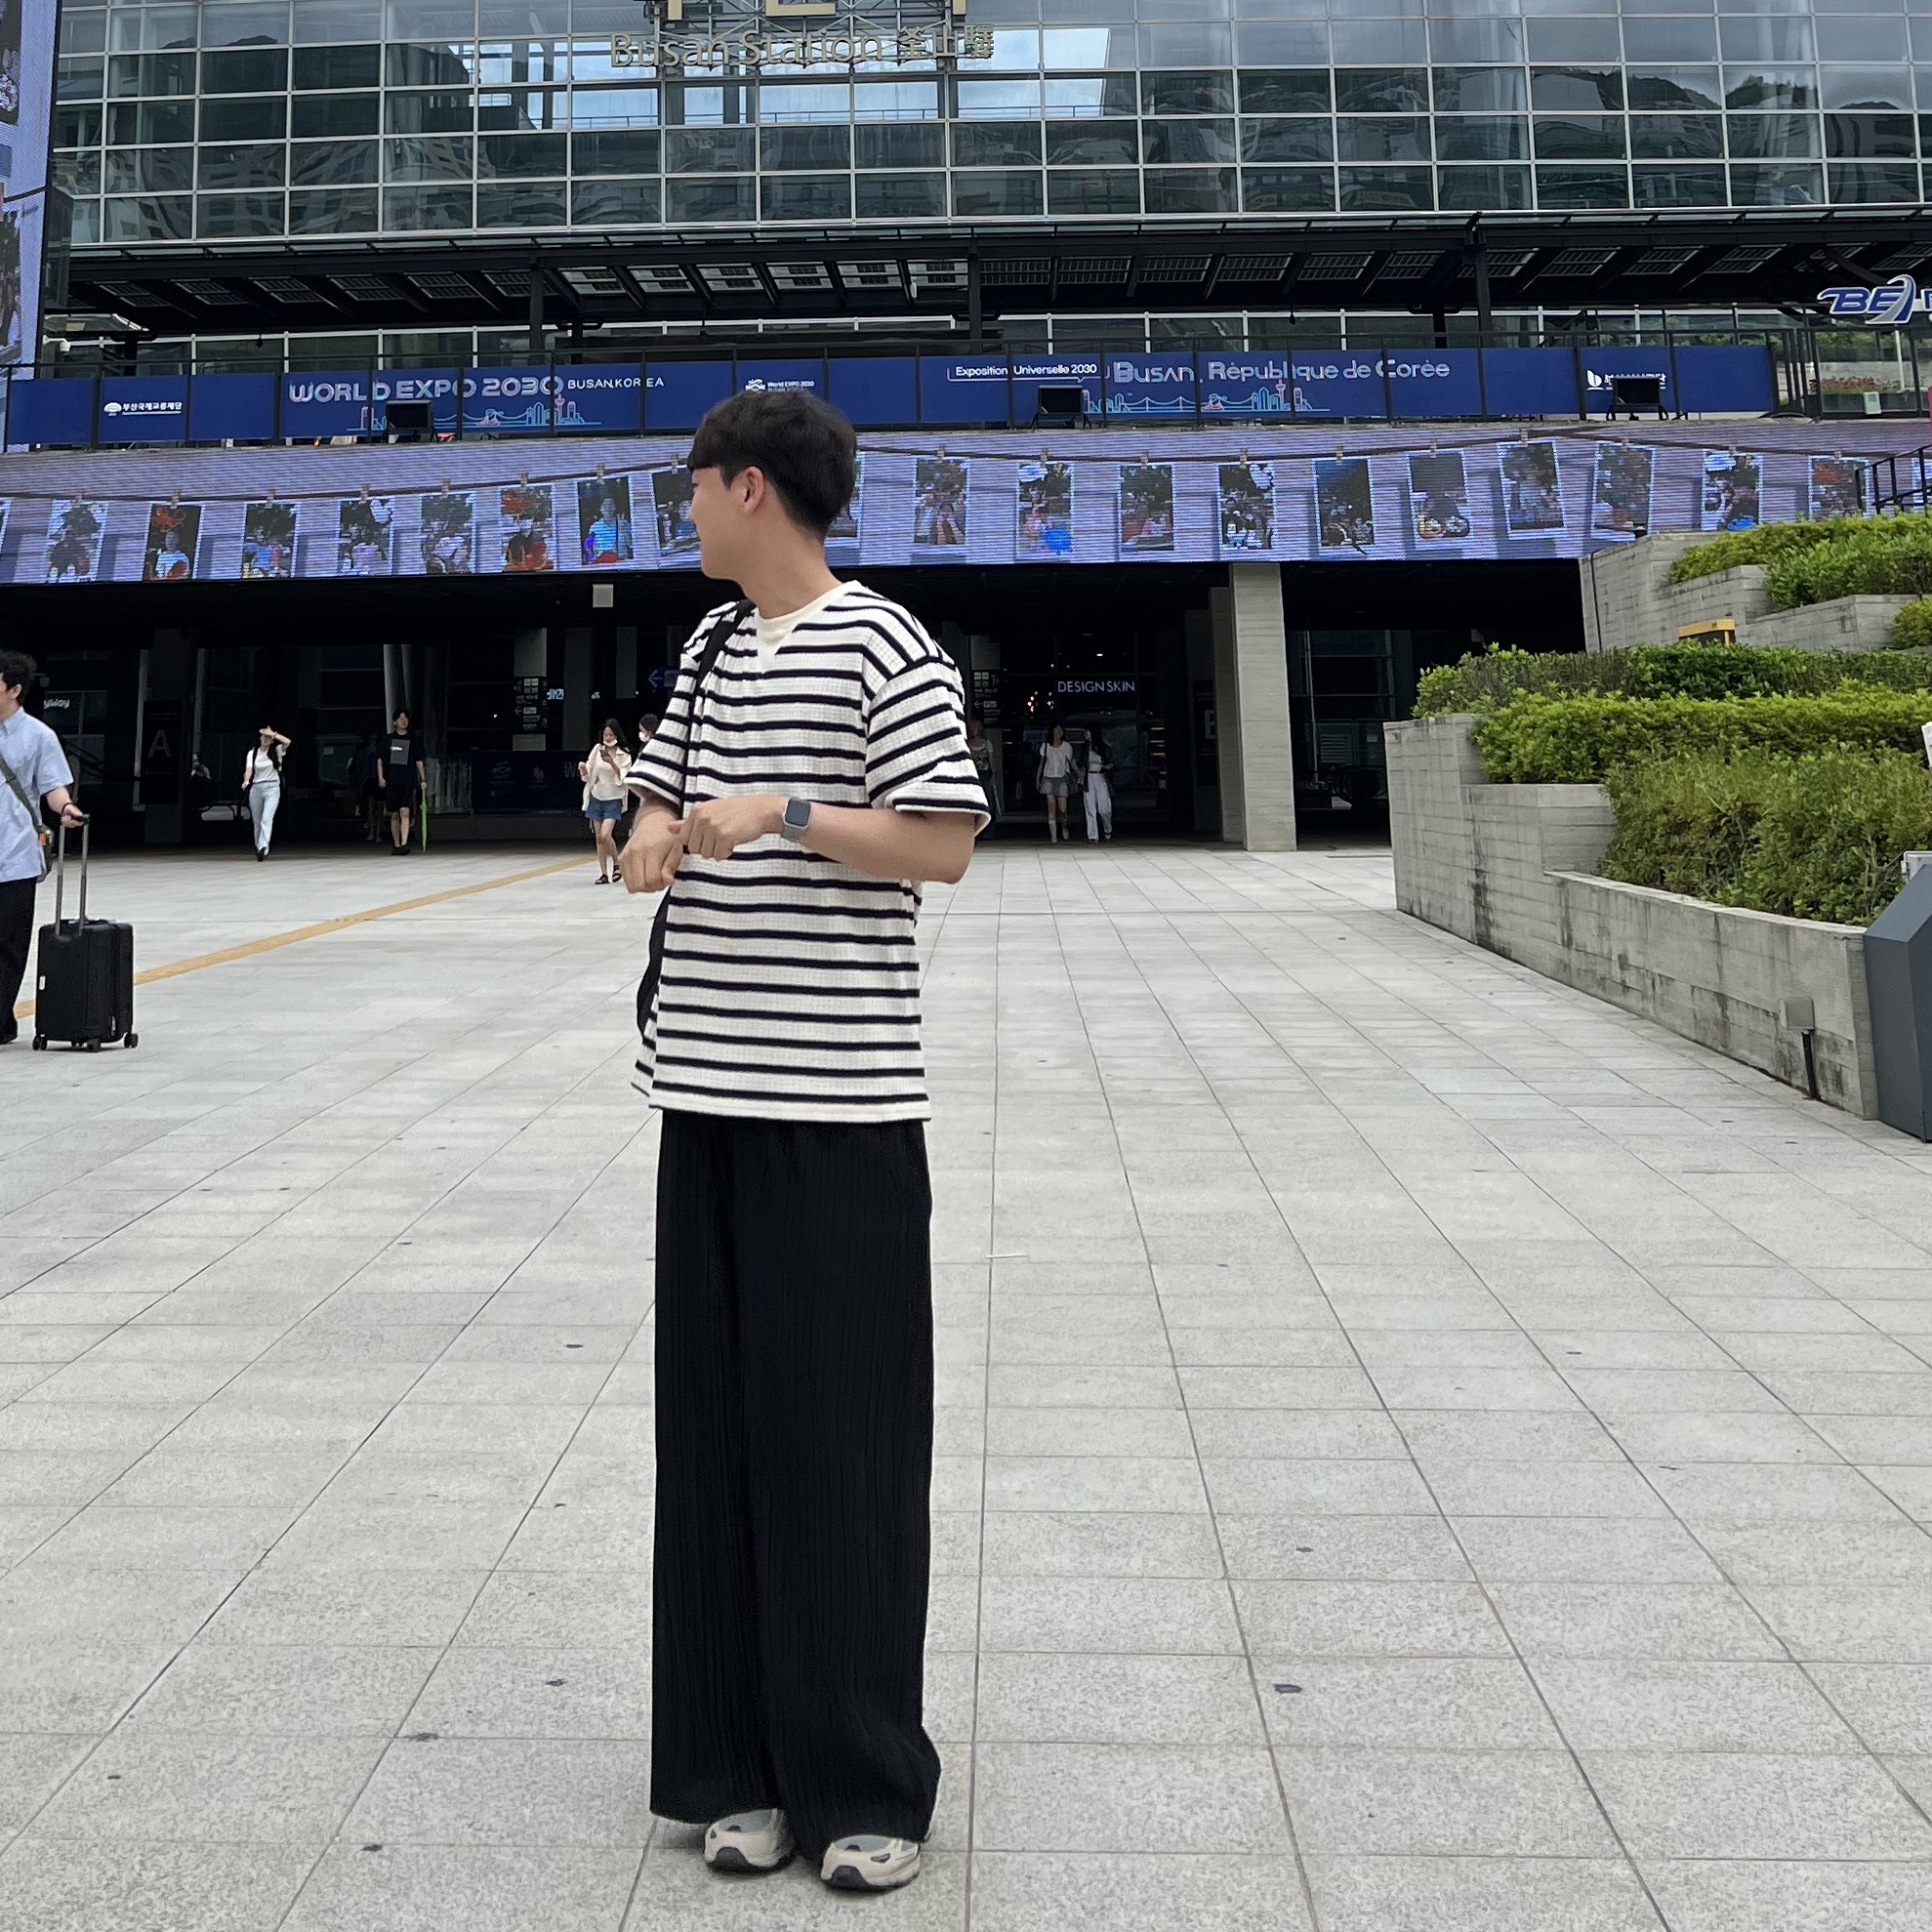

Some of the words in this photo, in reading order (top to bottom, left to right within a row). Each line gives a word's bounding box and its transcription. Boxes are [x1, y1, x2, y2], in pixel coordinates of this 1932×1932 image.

[611, 31, 731, 67] Busan
[739, 28, 883, 65] Station
[955, 365, 1008, 378] Exposition
[1012, 364, 1070, 376] Universelle
[1070, 363, 1097, 375] 2030
[1342, 359, 1372, 380] de
[288, 379, 391, 403] WORLD
[395, 378, 477, 399] EXPO
[481, 375, 564, 397] 2030
